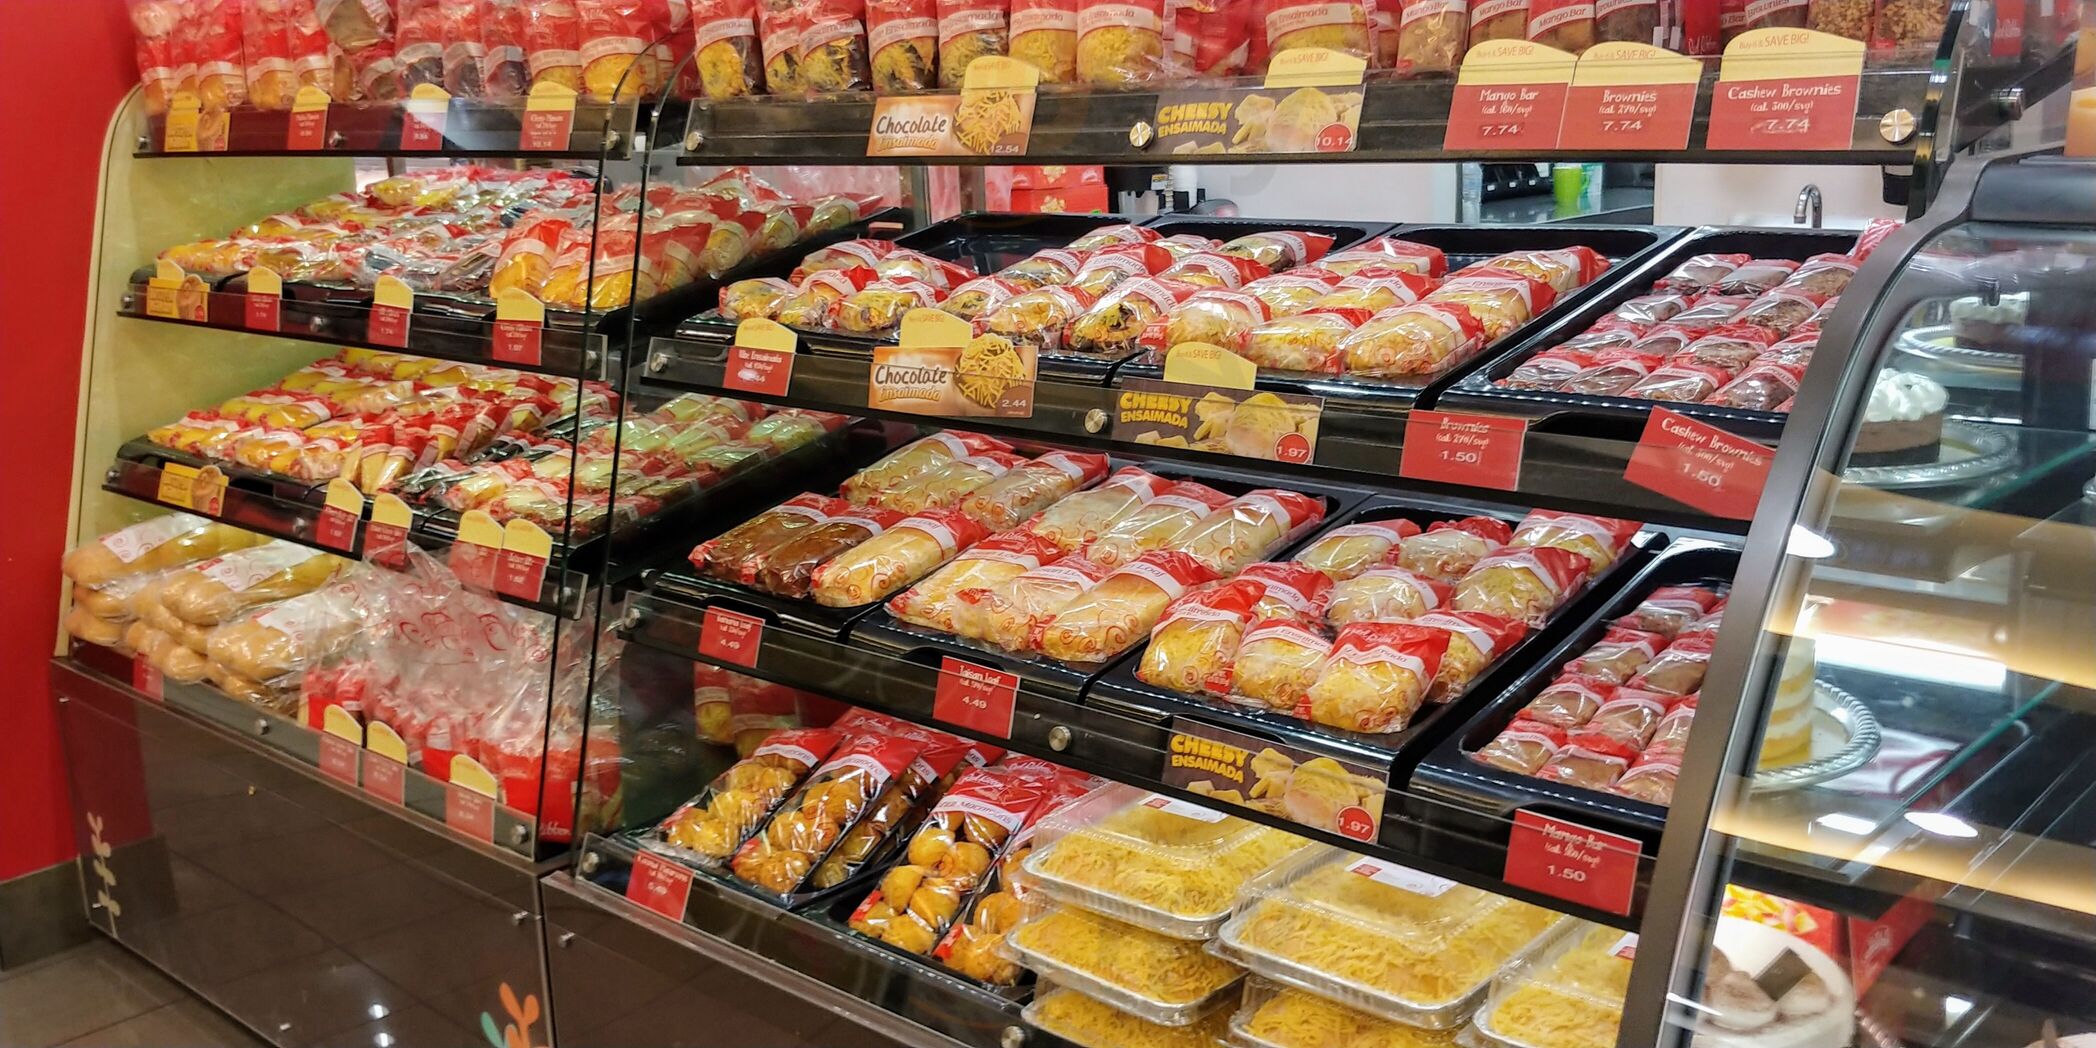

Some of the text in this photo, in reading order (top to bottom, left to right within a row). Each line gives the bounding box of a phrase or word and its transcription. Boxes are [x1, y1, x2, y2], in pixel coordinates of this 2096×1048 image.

[1569, 6, 1586, 17] Bar
[1764, 34, 1790, 47] SAVE
[1791, 32, 1809, 45] BIG!
[1498, 46, 1517, 57] SAVE
[1479, 88, 1539, 104] Mango Bar
[1602, 89, 1657, 103] Brownies
[1727, 83, 1842, 100] Cashew Brownies
[1157, 102, 1234, 124] CHEESY
[1750, 101, 1768, 112] (cal.
[876, 113, 947, 134] Chocolate
[1157, 120, 1228, 138] ENSAIMADA
[1481, 124, 1519, 136] 7.74
[1601, 119, 1643, 131] 7.74
[1766, 117, 1811, 132] 7.74
[875, 365, 948, 385] Chocolate
[879, 385, 942, 402] Ensaimada
[1001, 398, 1027, 408] 2.44
[1119, 391, 1194, 414] CHEESY
[1120, 409, 1190, 429] ENSAIMADA
[1439, 416, 1491, 434] Brownies
[1661, 417, 1763, 466] Cashew Brownies
[1276, 444, 1308, 458] 1.97
[1440, 449, 1477, 463] 1.50
[1682, 462, 1723, 487] 1.50
[962, 695, 988, 709] 4.49
[1169, 733, 1250, 767] CHEESY
[1170, 754, 1245, 784] ENSAIMADA
[1337, 818, 1371, 833] 1.97
[1541, 822, 1608, 851] Mango Bar
[1546, 864, 1587, 882] 1.50
